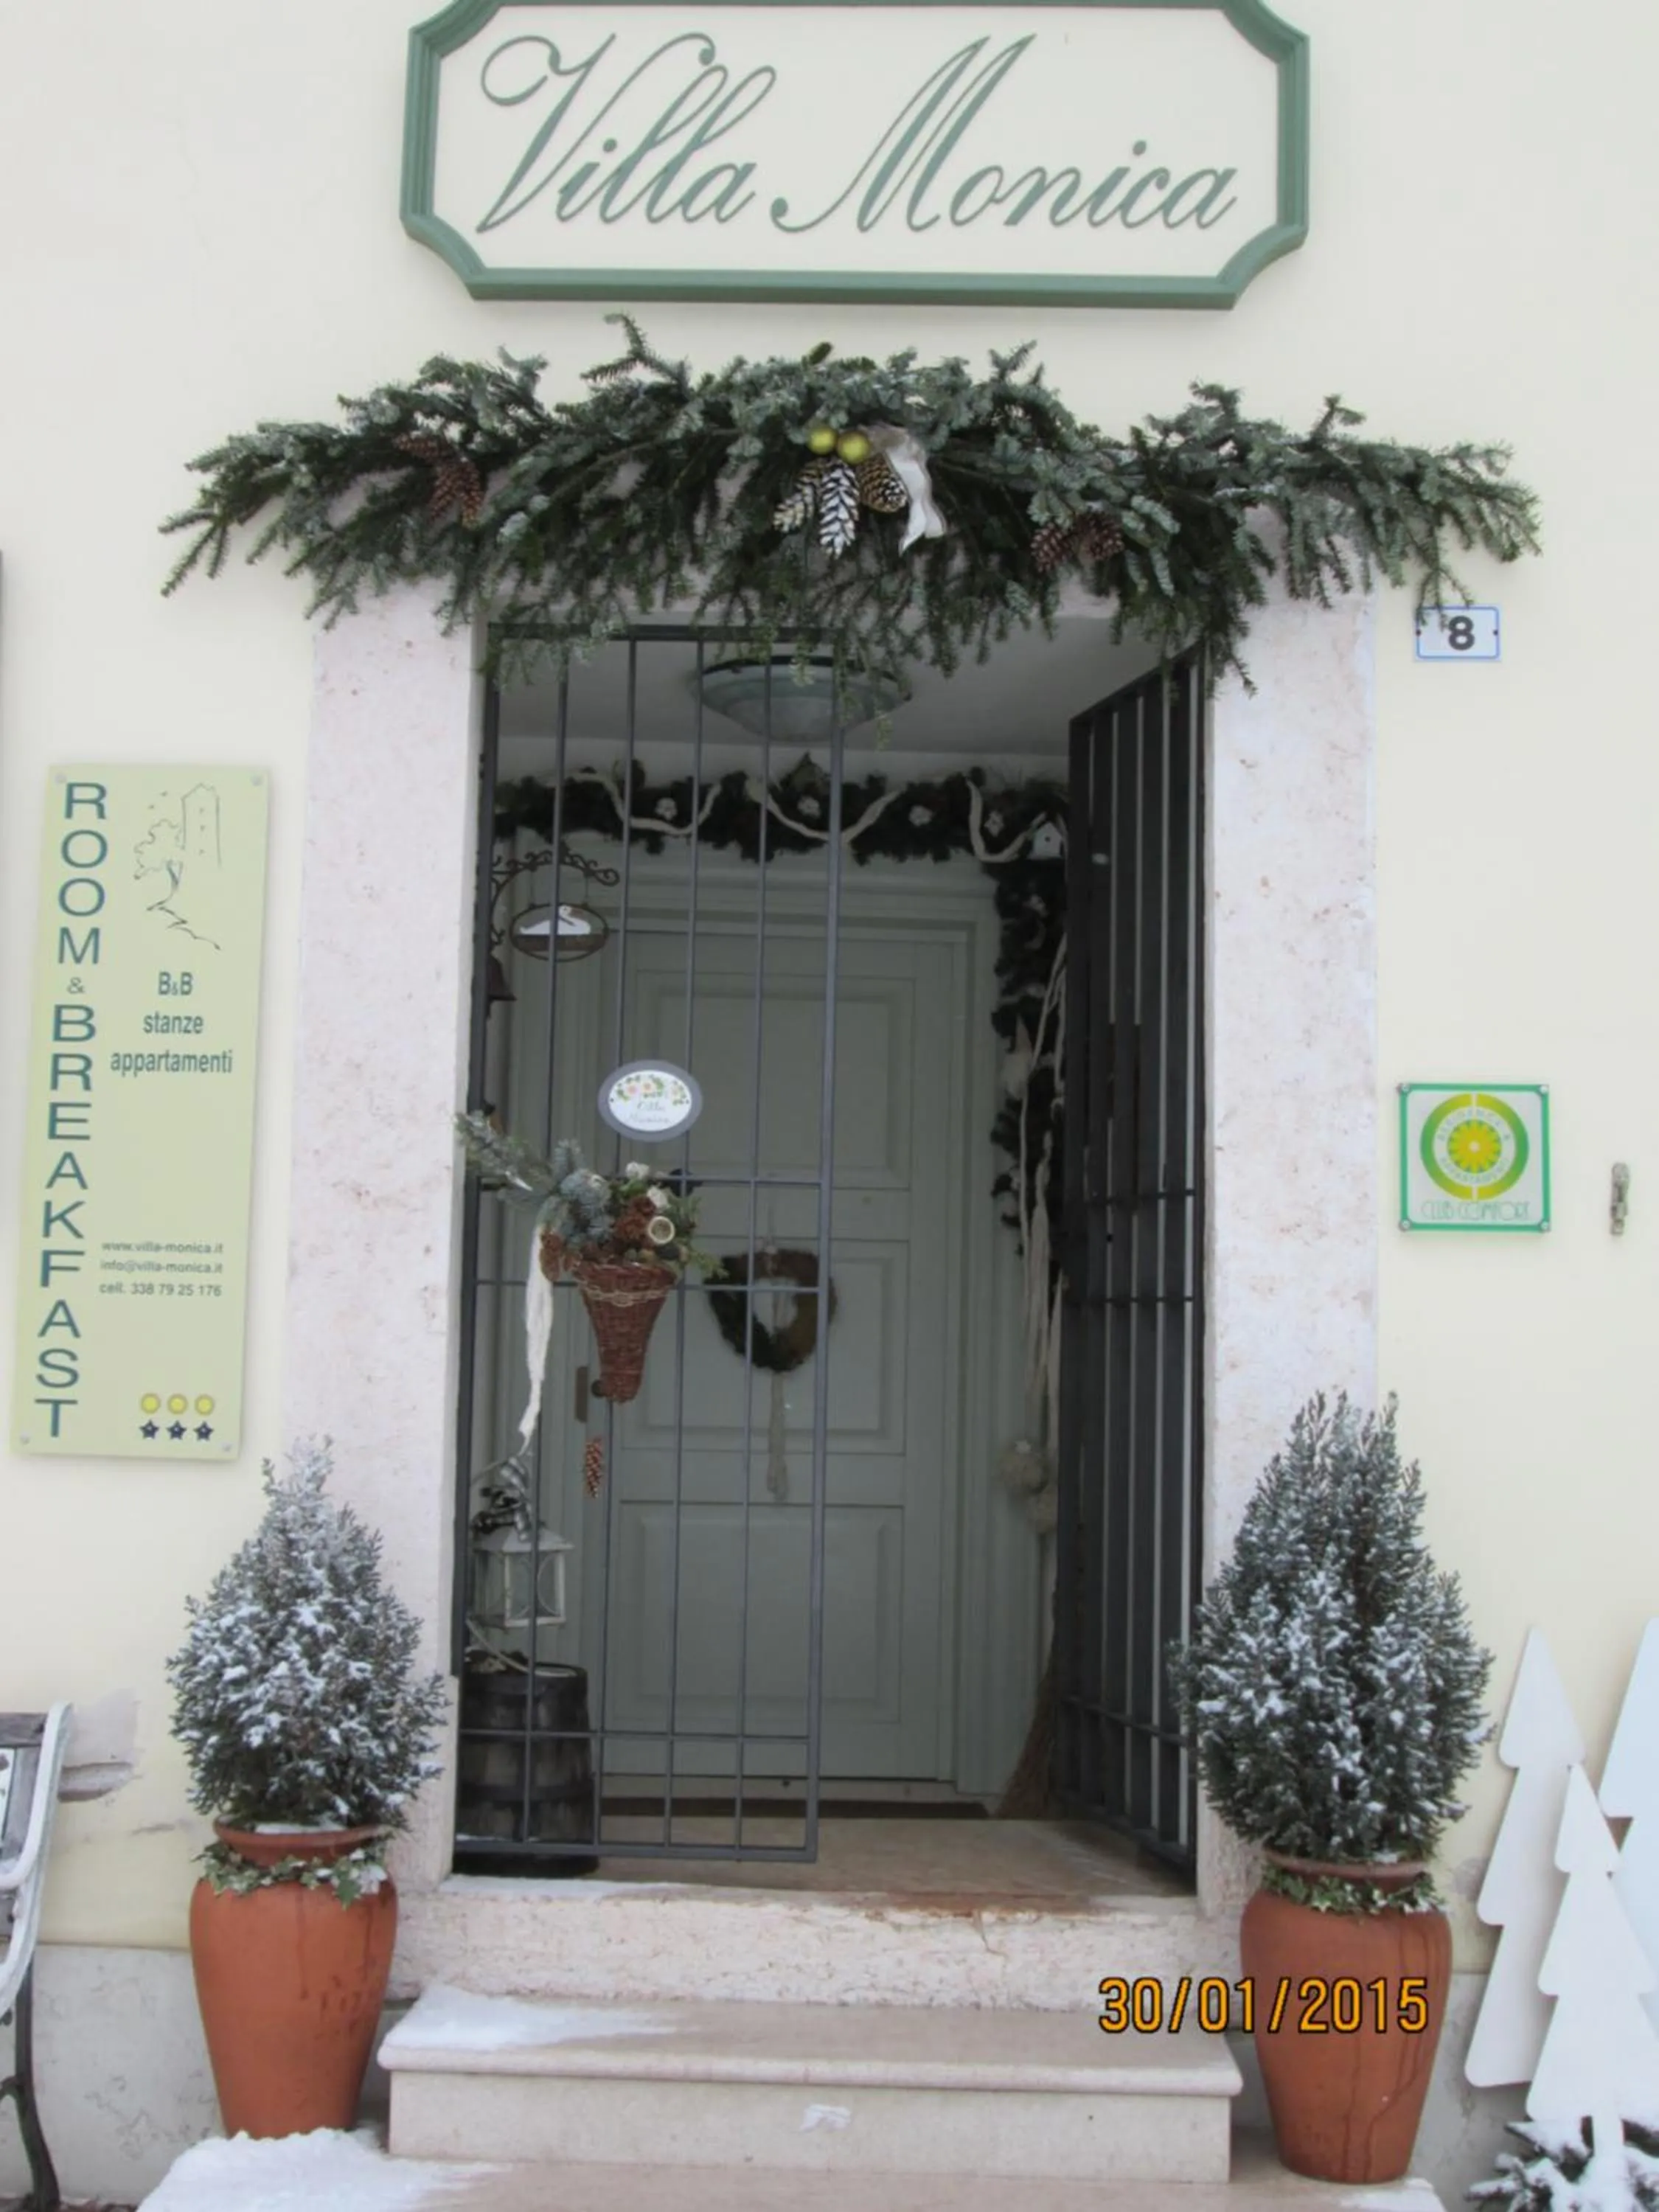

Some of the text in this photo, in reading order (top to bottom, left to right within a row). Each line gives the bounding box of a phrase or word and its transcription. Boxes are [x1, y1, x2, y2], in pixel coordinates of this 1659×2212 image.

[476, 32, 1238, 234] Villa Monica
[1448, 615, 1475, 651] 8
[58, 782, 108, 965] ROOM
[158, 971, 193, 996] B&B
[143, 1011, 204, 1034] stanze
[111, 1049, 233, 1077] appartamenti
[34, 1004, 97, 1438] BREAKFAST
[102, 1241, 223, 1253] www.villa-monica.it
[100, 1259, 223, 1274] info@villa-monica.it
[131, 1281, 155, 1295] 338
[158, 1283, 174, 1295] 79
[177, 1283, 194, 1296] 25
[198, 1284, 222, 1297] 176
